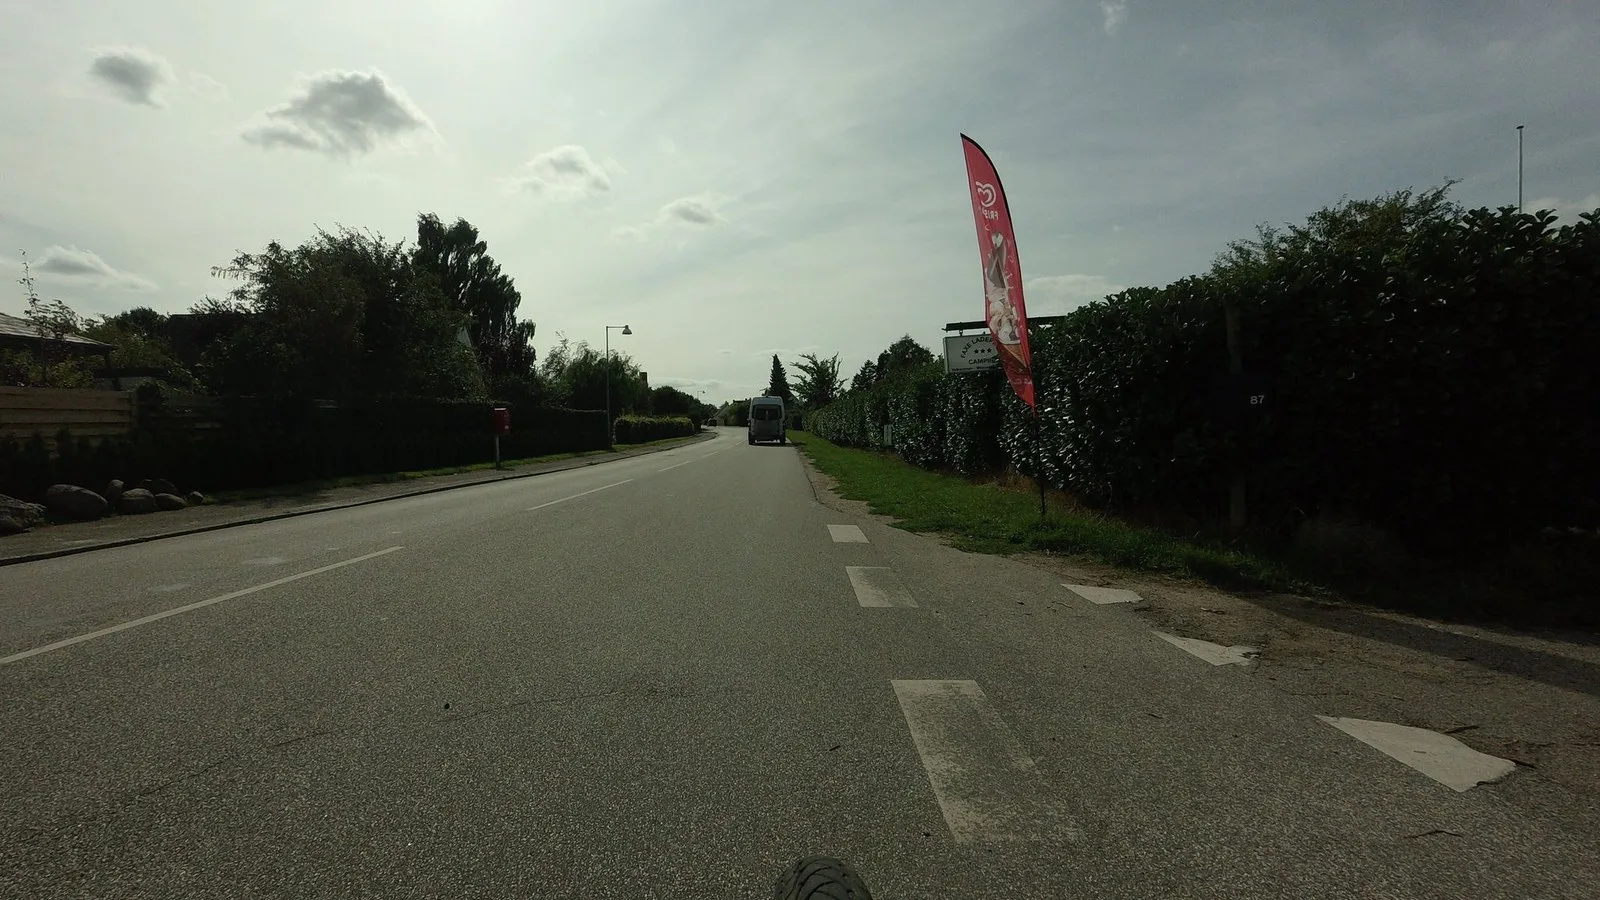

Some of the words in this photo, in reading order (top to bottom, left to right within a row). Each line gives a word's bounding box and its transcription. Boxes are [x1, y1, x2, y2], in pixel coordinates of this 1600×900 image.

[960, 342, 971, 359] FAXE
[971, 336, 993, 344] LADE
[1250, 395, 1265, 405] 87
